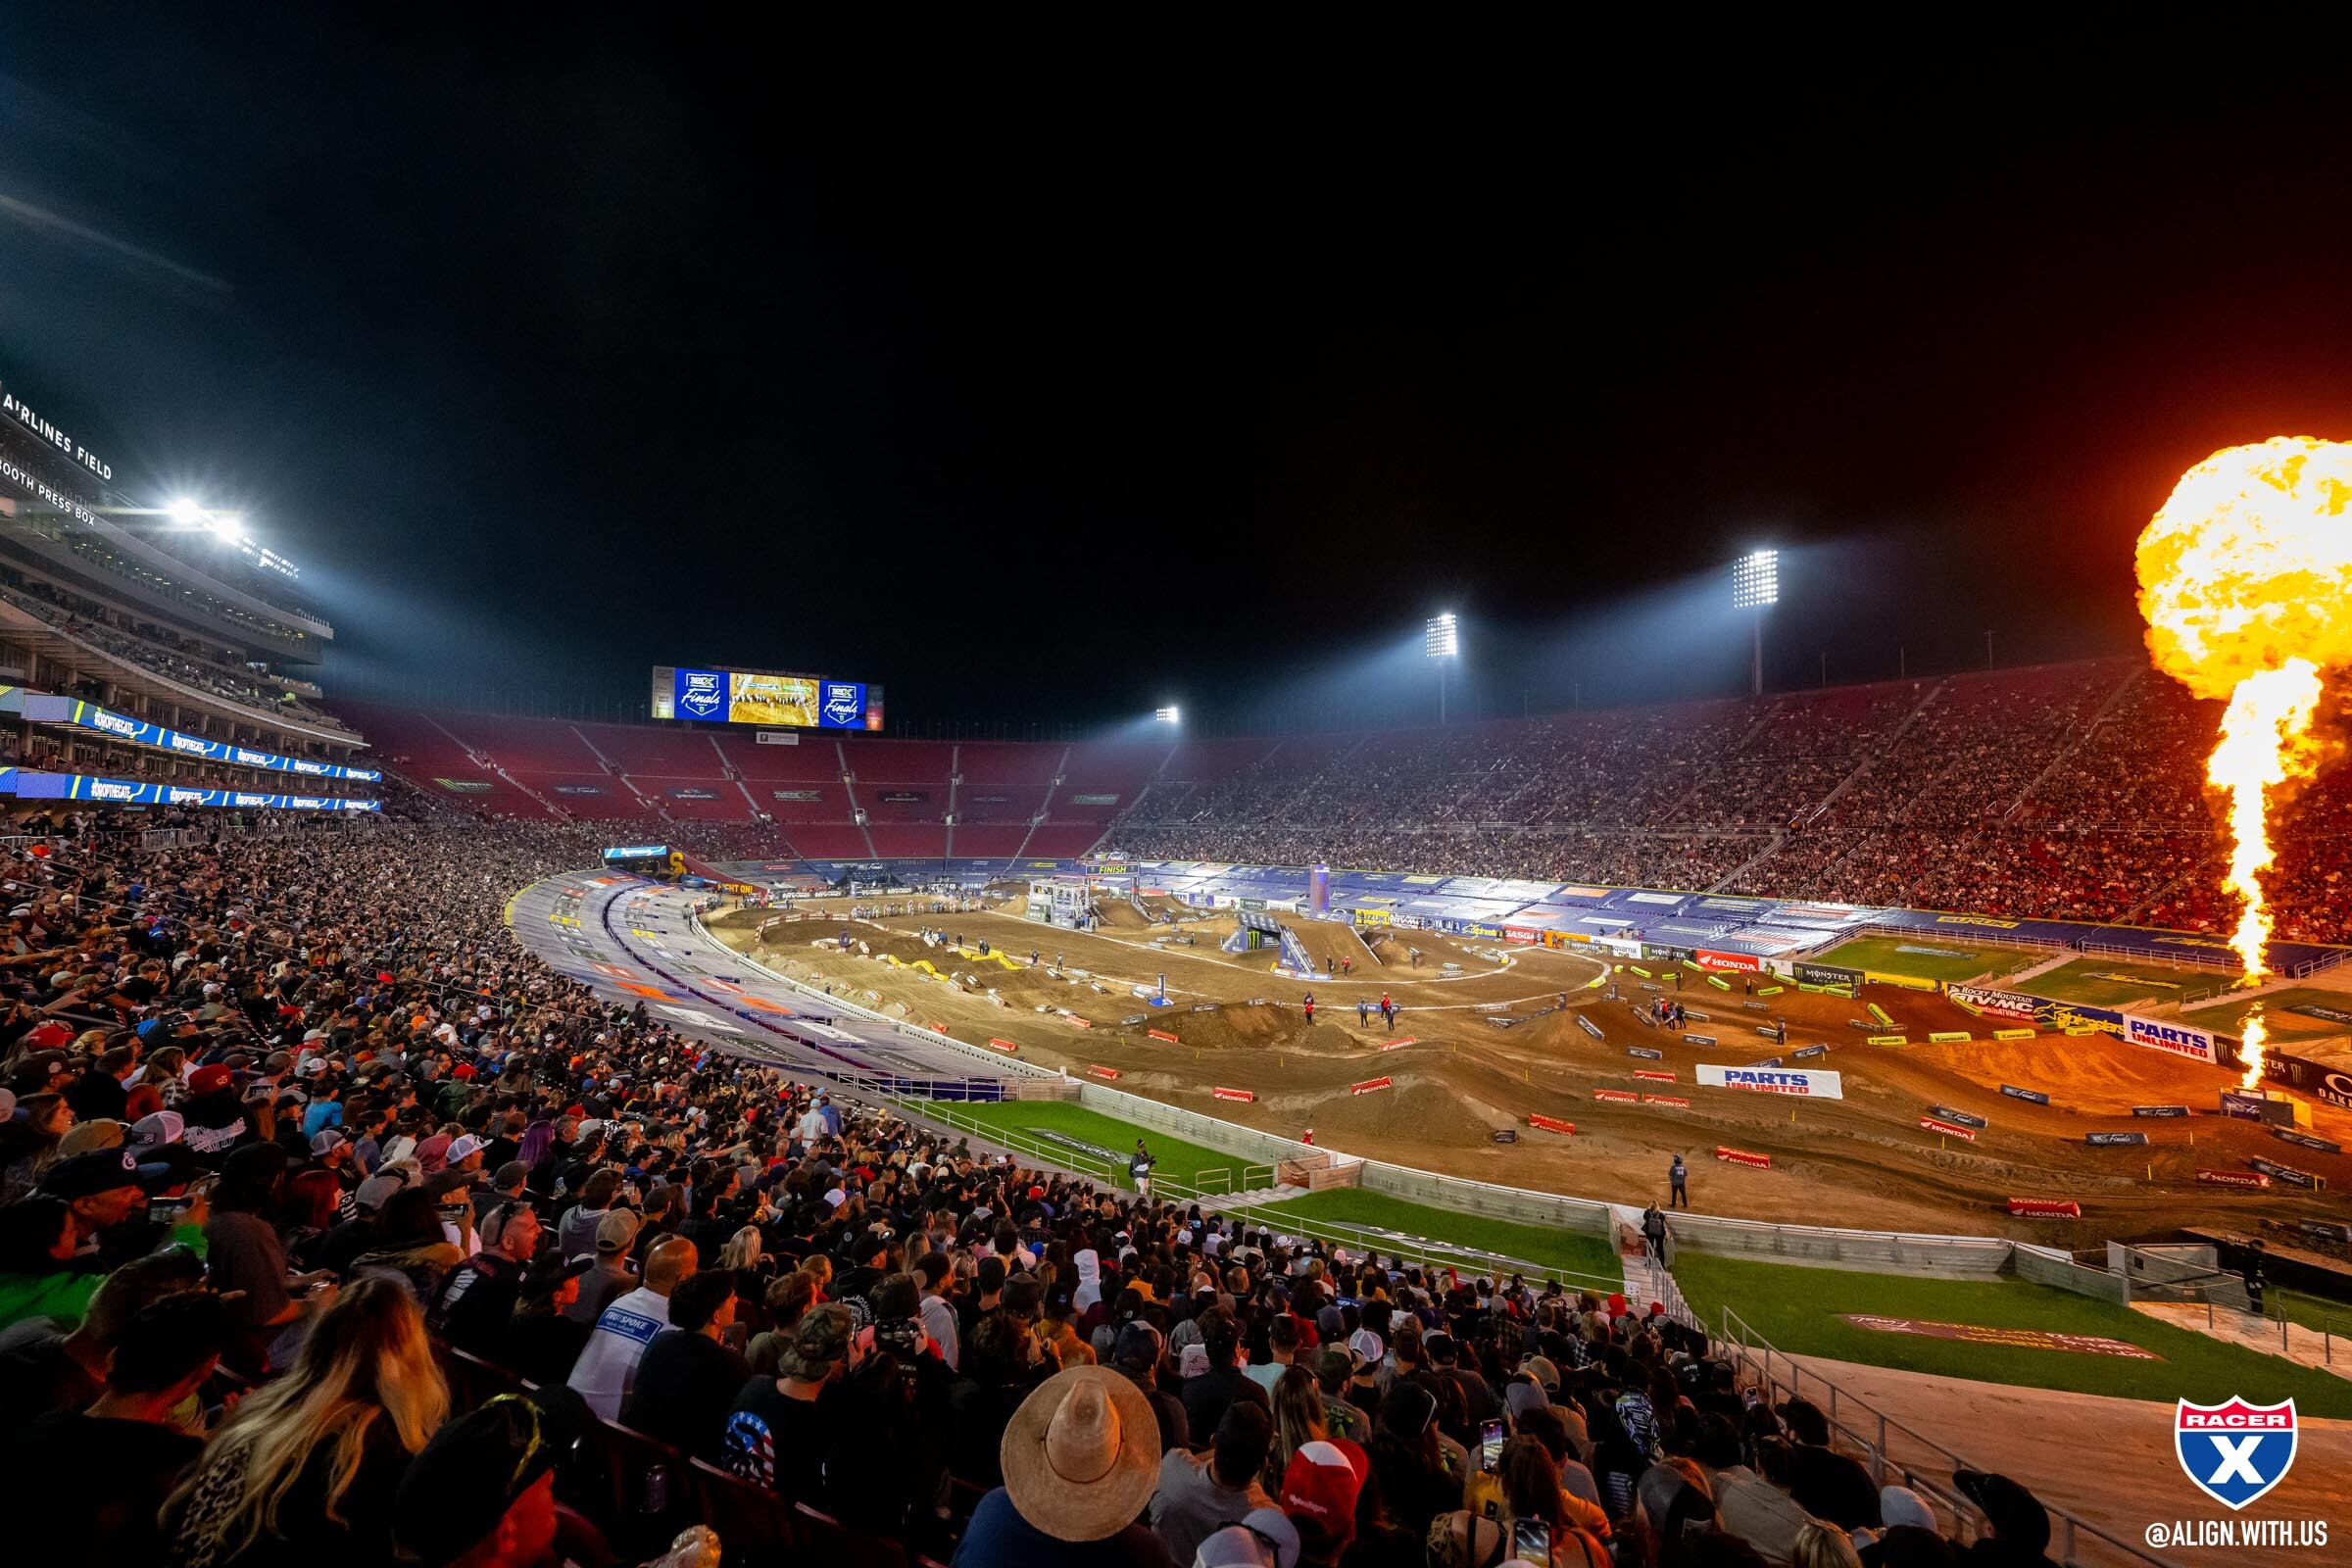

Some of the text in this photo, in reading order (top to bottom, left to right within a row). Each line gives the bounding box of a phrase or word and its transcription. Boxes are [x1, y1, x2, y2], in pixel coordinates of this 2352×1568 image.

[3, 393, 112, 480] AIRLINES FIELD
[38, 484, 72, 513] PRESS
[75, 507, 95, 526] BOX
[681, 688, 720, 705] Finals
[824, 699, 858, 713] Finals
[1652, 949, 1686, 958] MONTER
[1712, 958, 1757, 971] HONDA
[1806, 969, 1850, 982] MONSTER
[1962, 986, 1990, 997] ROCKY
[1990, 990, 2034, 1004] MOUNTAIN
[2001, 1031, 2033, 1040] Kawasaki
[2131, 1020, 2207, 1050] PARTS
[1389, 1041, 1413, 1051] HONDA
[2132, 1032, 2208, 1058] UNLIMITED
[1725, 1070, 1808, 1086] PARTS
[1361, 1083, 1390, 1094] HONDA
[1726, 1082, 1809, 1095] UNLIMITED
[1222, 1094, 1250, 1102] HONDA
[1604, 1095, 1637, 1103] HONDA
[1654, 1100, 1688, 1108] HONDA
[1931, 1124, 1971, 1140] HONDA
[2109, 1133, 2132, 1143] Finals
[1729, 1157, 1769, 1169] HONDA
[2211, 1174, 2259, 1186] HONDA
[2025, 1210, 2077, 1219] HONDA
